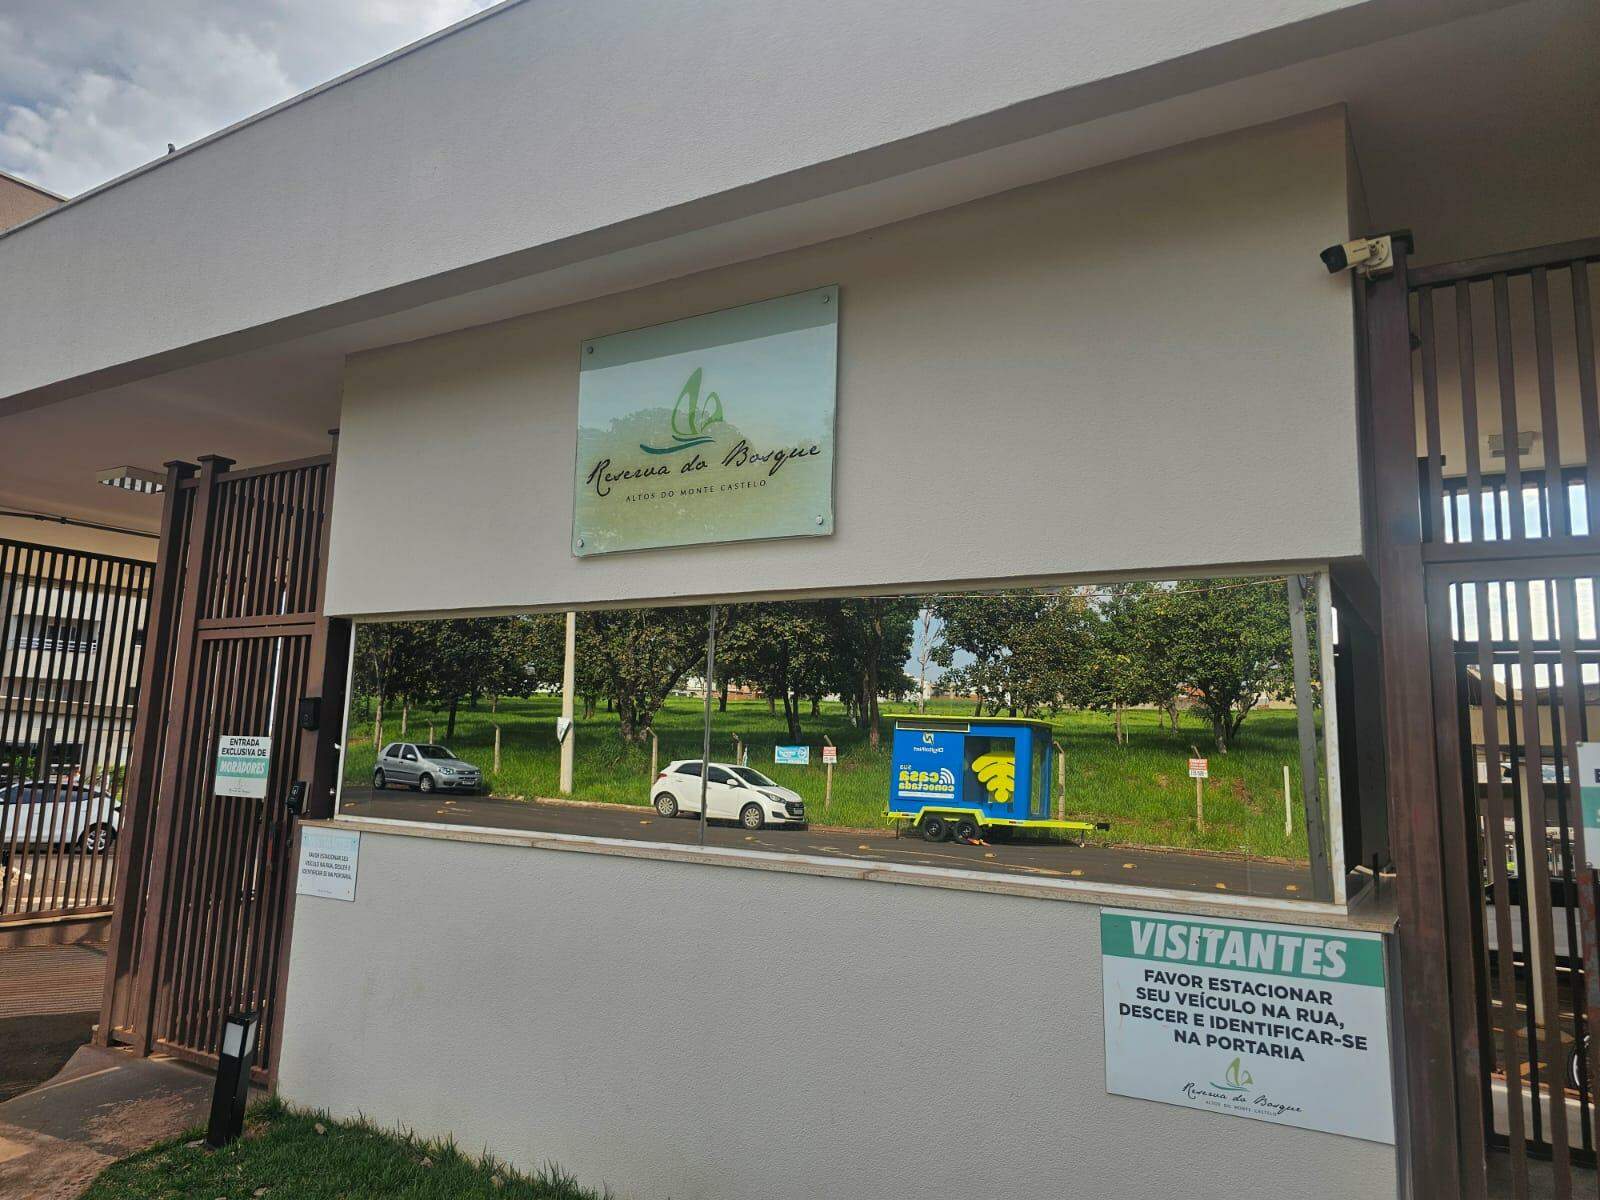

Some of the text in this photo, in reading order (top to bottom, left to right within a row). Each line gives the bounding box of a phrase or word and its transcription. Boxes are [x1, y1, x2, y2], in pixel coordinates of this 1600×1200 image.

[586, 439, 821, 497] Reserva do Bosque
[625, 480, 767, 503] ALTOS DO MONTE CASTELO
[221, 747, 267, 757] EXCLUSIVA DE
[229, 738, 260, 746] ENTRADA
[1130, 919, 1348, 978] VISITANTES
[1144, 969, 1333, 1006] FAVOR ESTACIONAR
[1136, 987, 1345, 1030] SEU VEÍCULO NA RUA,
[1119, 1002, 1368, 1051] DESCER E IDENTIFICAR-SE
[1173, 1029, 1305, 1062] NA PORTARIA
[1182, 1082, 1302, 1114] Reserva do Bosque
